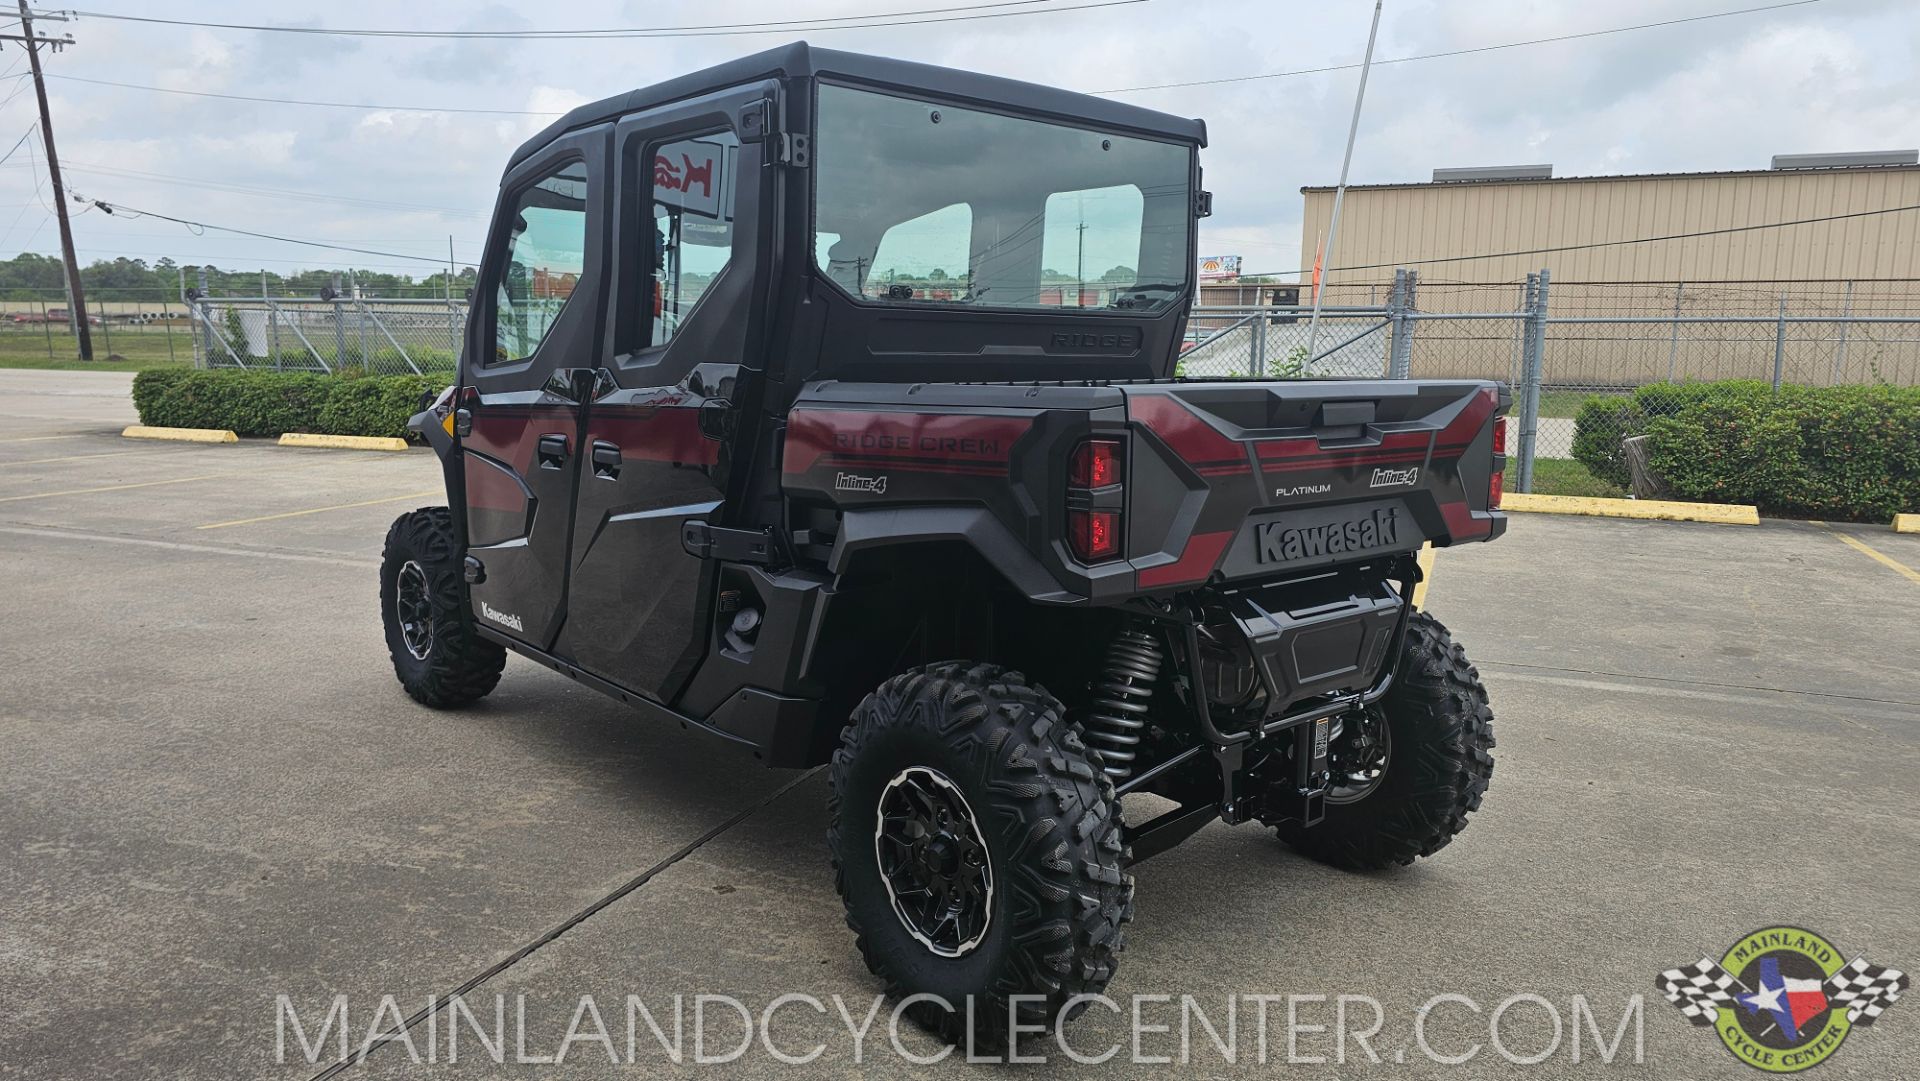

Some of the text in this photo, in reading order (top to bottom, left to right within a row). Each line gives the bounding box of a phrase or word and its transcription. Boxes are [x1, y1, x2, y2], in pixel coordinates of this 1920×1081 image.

[1050, 331, 1134, 348] RIDGE
[832, 432, 1000, 455] RIDGE CREW
[835, 472, 887, 494] Inline-4
[1370, 467, 1419, 488] Inline-4
[1276, 484, 1332, 497] PLATINUM
[1255, 507, 1400, 564] Kawasaki
[481, 601, 523, 633] Kawasaki
